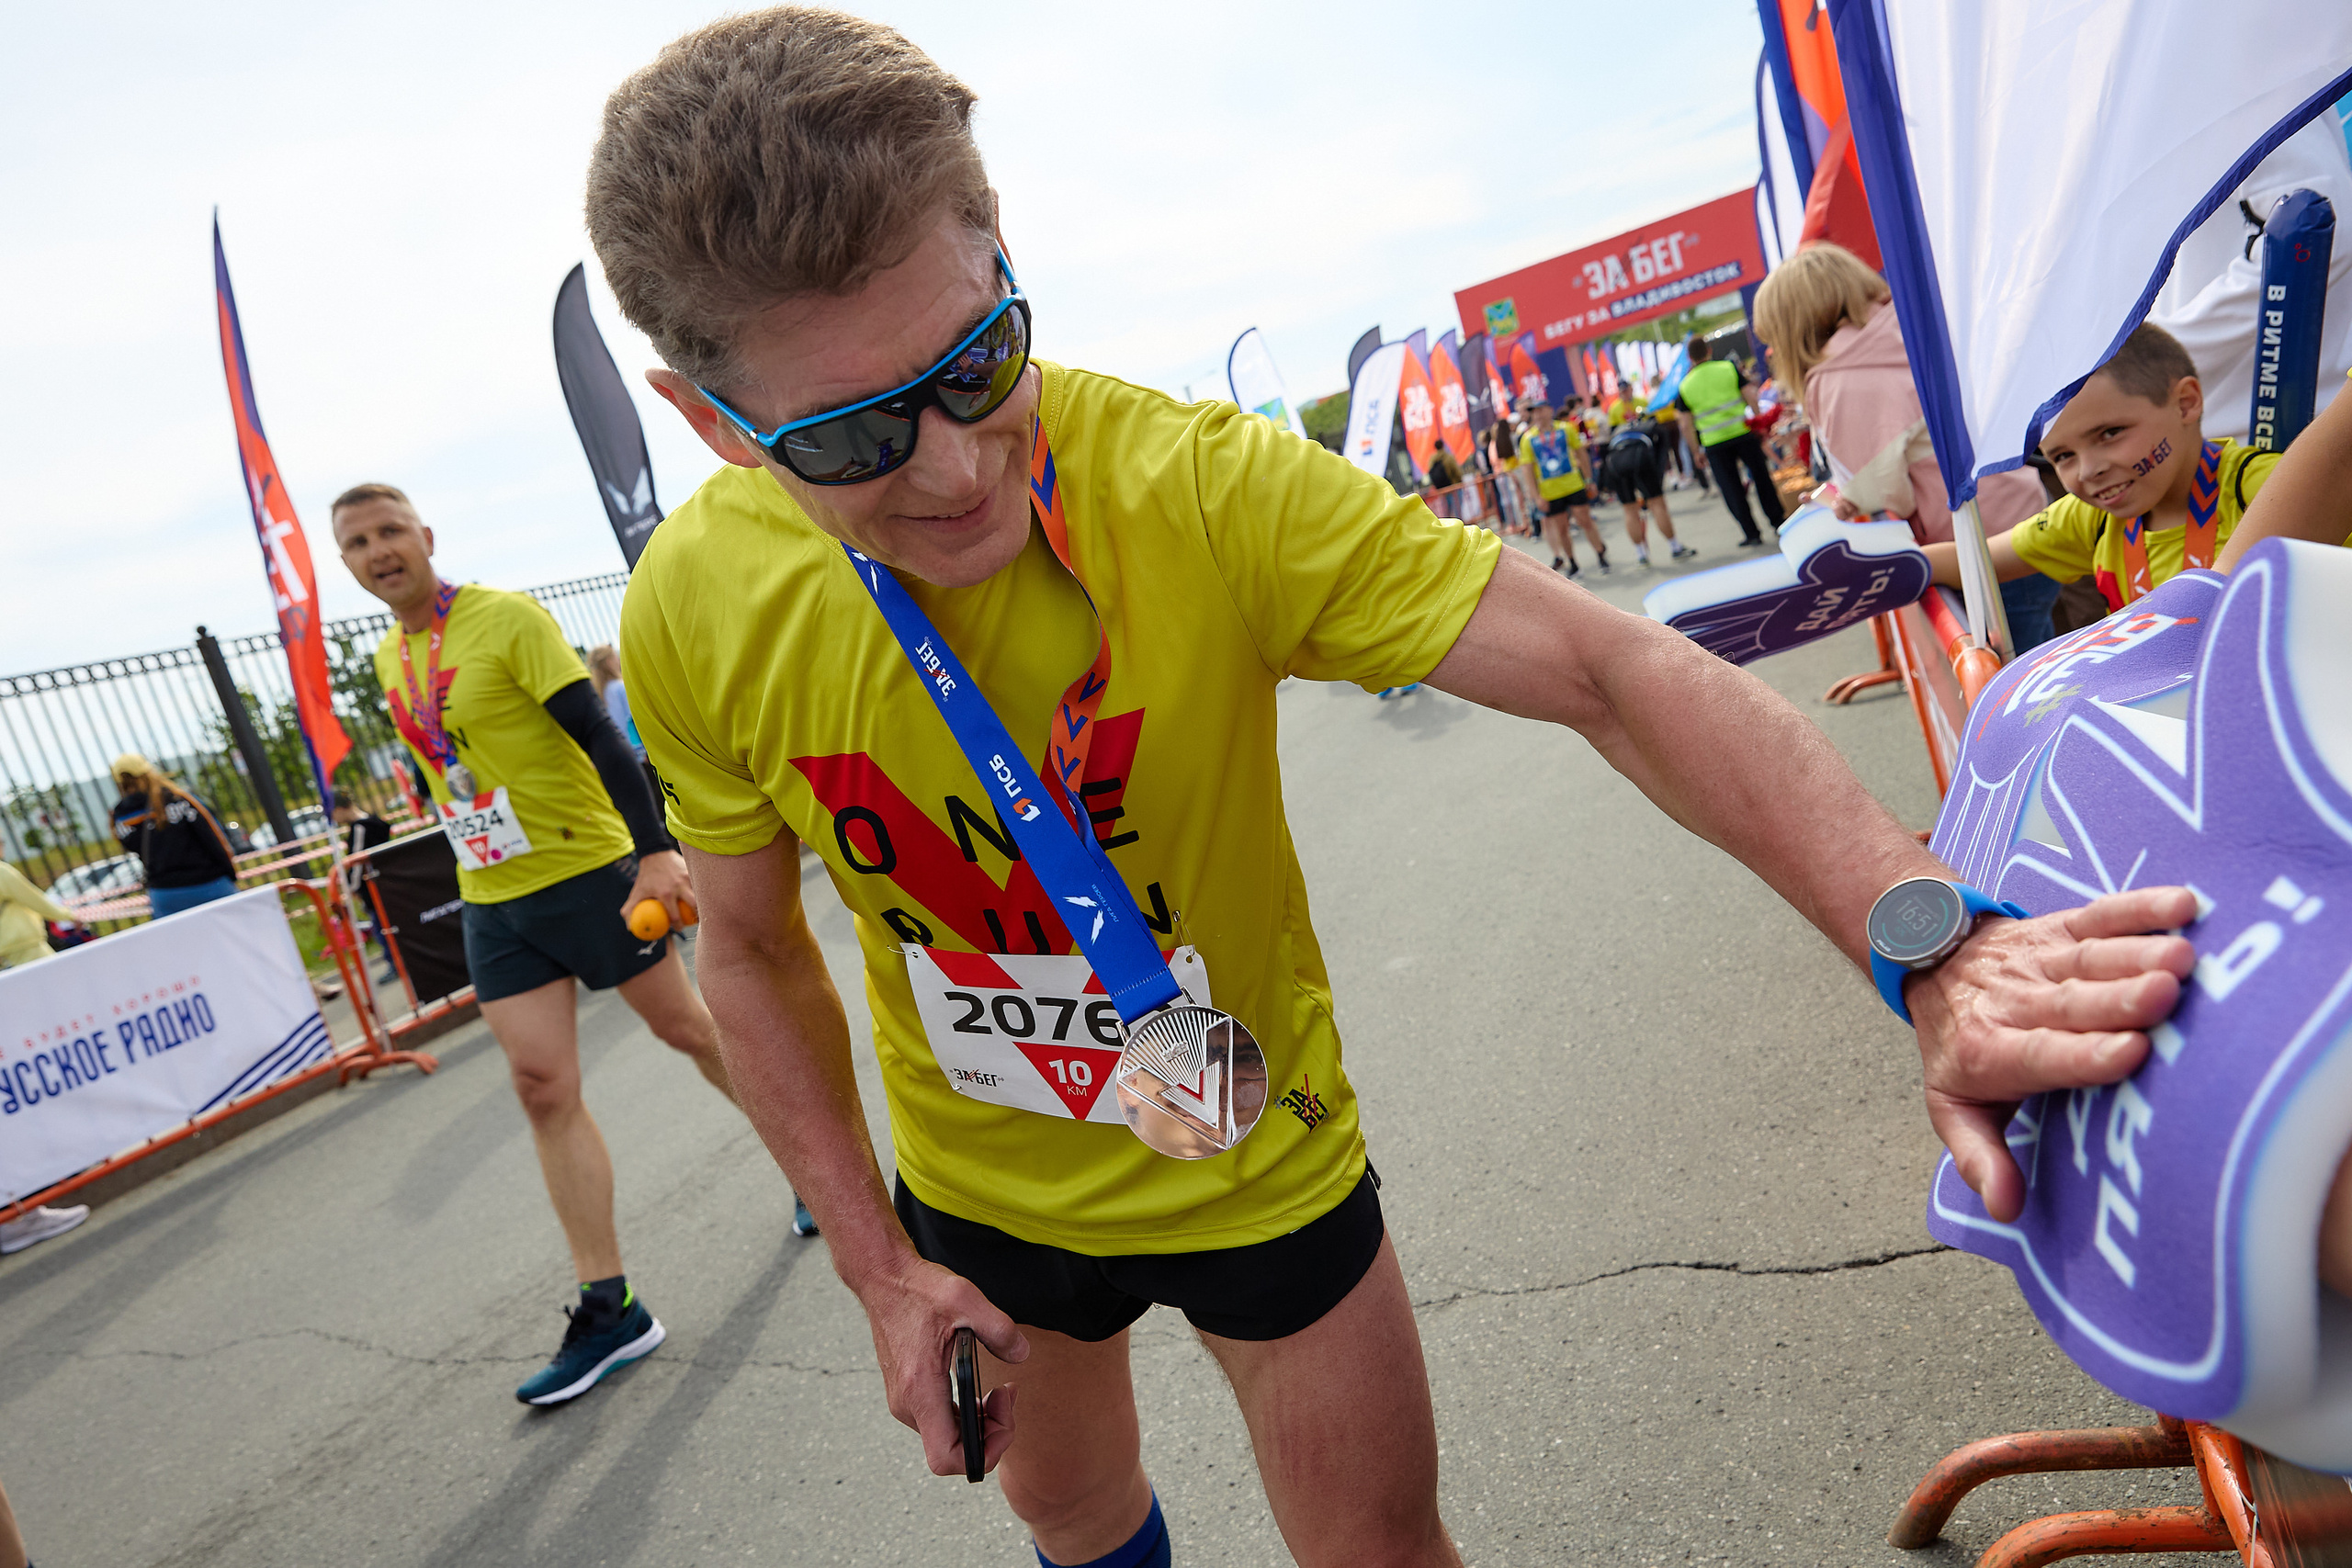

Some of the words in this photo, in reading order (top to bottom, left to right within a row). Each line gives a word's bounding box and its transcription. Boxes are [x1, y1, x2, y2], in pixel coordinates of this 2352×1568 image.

[1544, 314, 1584, 340] БЕГУ
[1586, 307, 1611, 323] ЗА
[1611, 262, 1741, 318] ВЛАДИВОСТОК
[2267, 284, 2287, 301] В
[2258, 310, 2284, 400] РИТМЕ
[1795, 586, 1850, 632] ДАЙ
[989, 753, 1023, 798] ПСБ
[833, 777, 1140, 875] ONE
[1895, 899, 1939, 938] 16:51
[23, 1013, 96, 1051] БУДЕТ
[112, 975, 201, 1016] ХОРОШО
[944, 991, 1172, 1047] 2076
[0, 1030, 119, 1114] УССКОЕ
[117, 992, 216, 1064] РАДИО
[1048, 1059, 1092, 1087] 10
[1067, 1085, 1088, 1097] КМ
